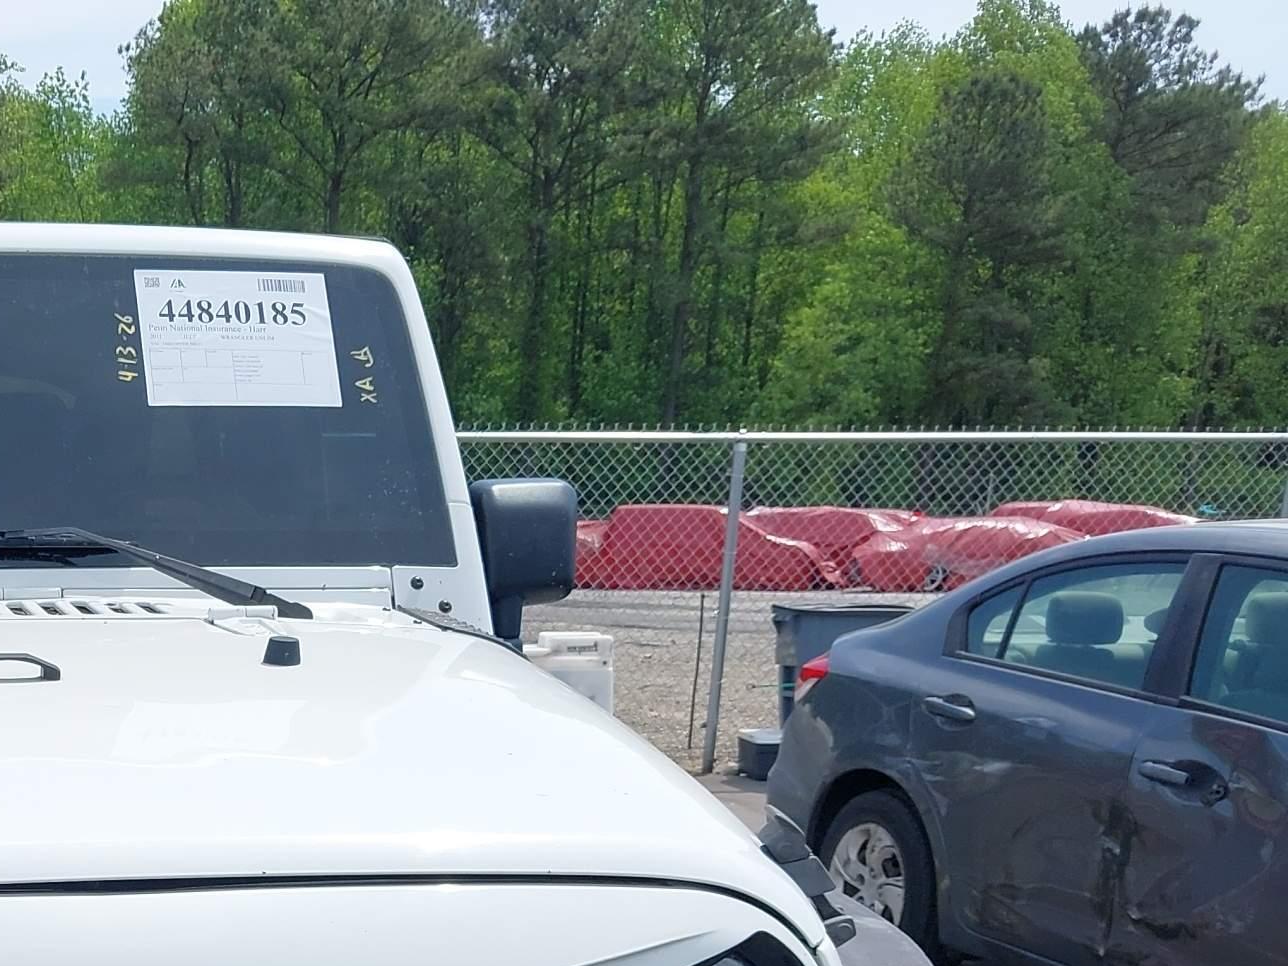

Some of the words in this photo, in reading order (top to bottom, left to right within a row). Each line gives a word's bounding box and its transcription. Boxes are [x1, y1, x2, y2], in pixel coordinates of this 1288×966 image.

[158, 298, 307, 326] 44840185
[148, 324, 168, 332] Penn
[170, 324, 202, 333] National
[205, 324, 242, 333] Insurance
